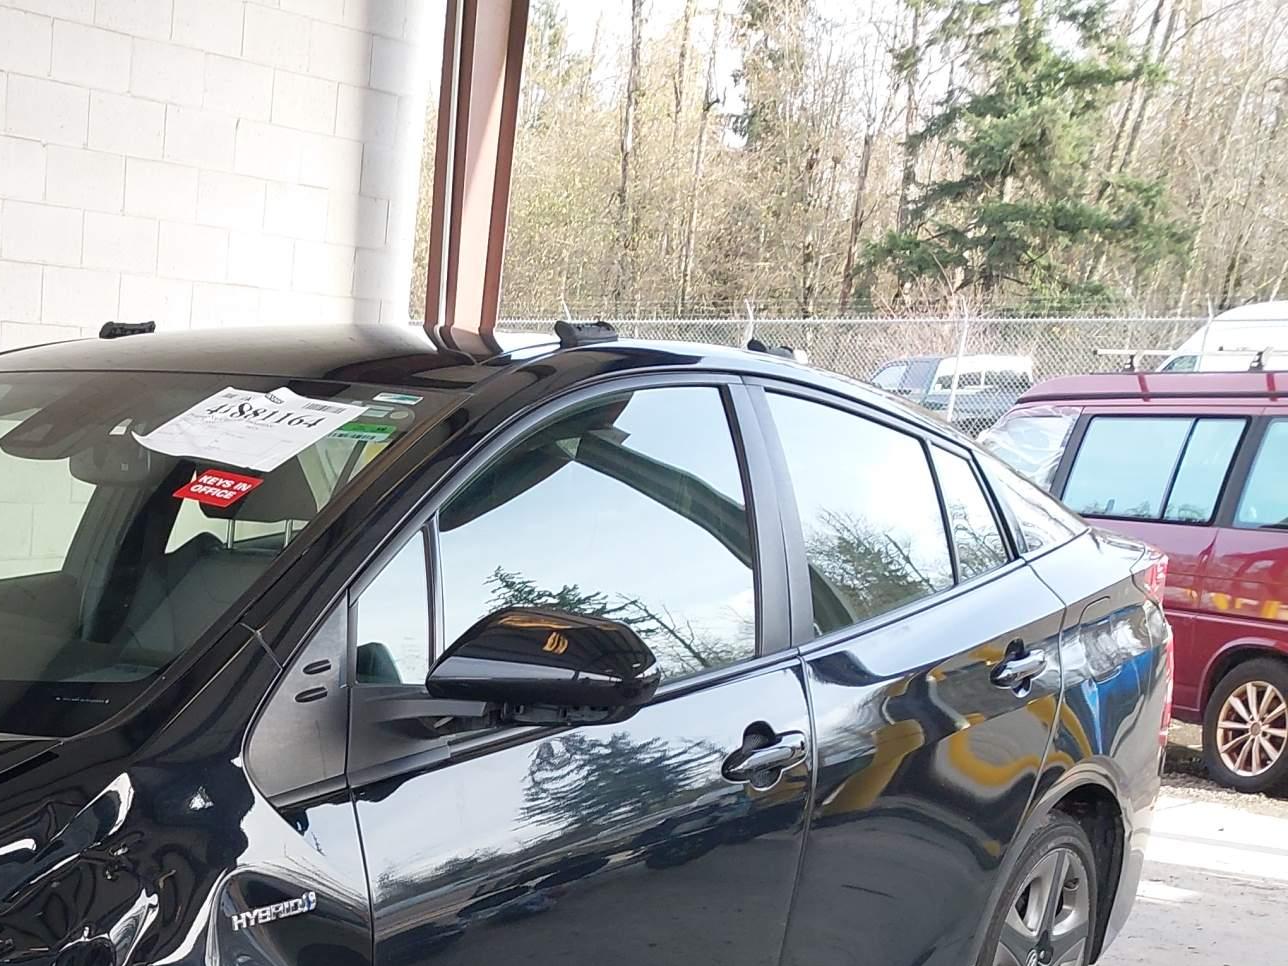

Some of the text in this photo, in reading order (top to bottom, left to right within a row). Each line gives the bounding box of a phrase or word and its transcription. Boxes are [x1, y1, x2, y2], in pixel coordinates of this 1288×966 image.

[190, 484, 237, 499] OFFICE
[198, 475, 252, 492] KEYS IN
[232, 898, 306, 931] HYBRID
